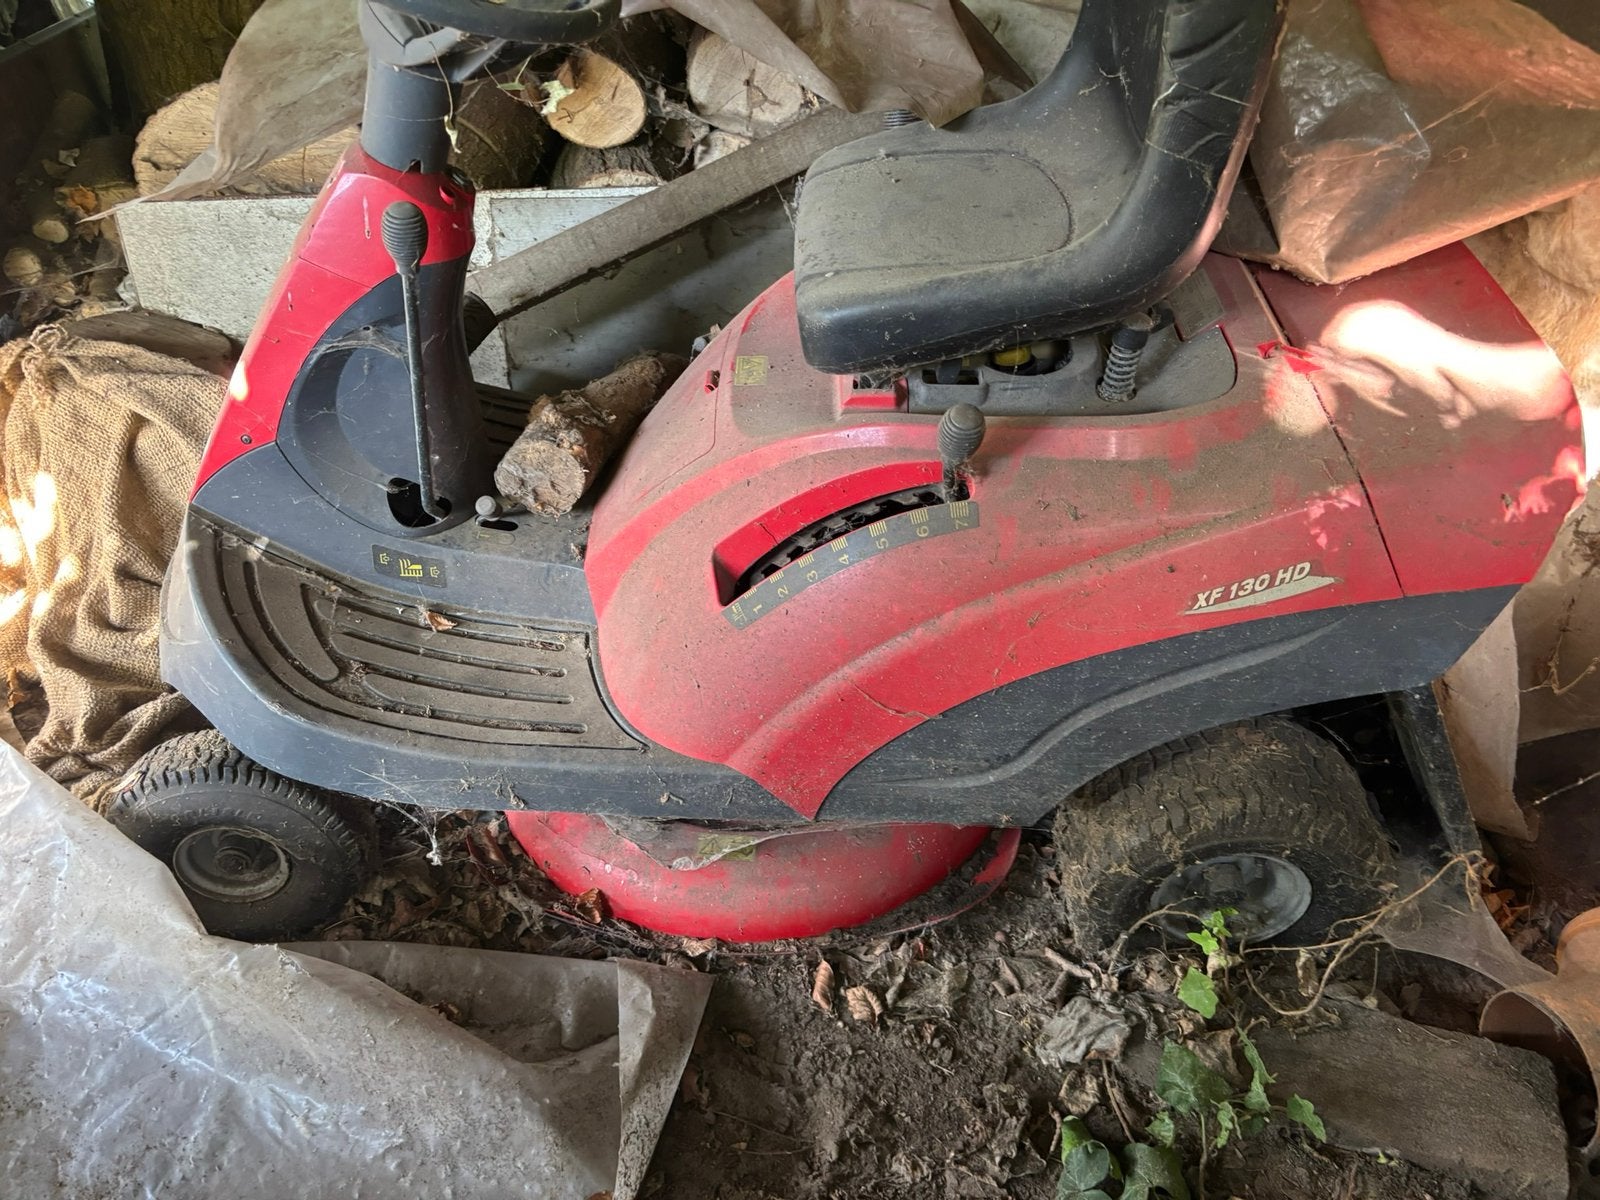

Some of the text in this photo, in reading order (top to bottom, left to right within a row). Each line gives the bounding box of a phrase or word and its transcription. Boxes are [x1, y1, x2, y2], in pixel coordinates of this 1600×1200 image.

[752, 520, 969, 614] 1 2 3 4 5 6 7
[1191, 561, 1312, 610] XF 130 HD
